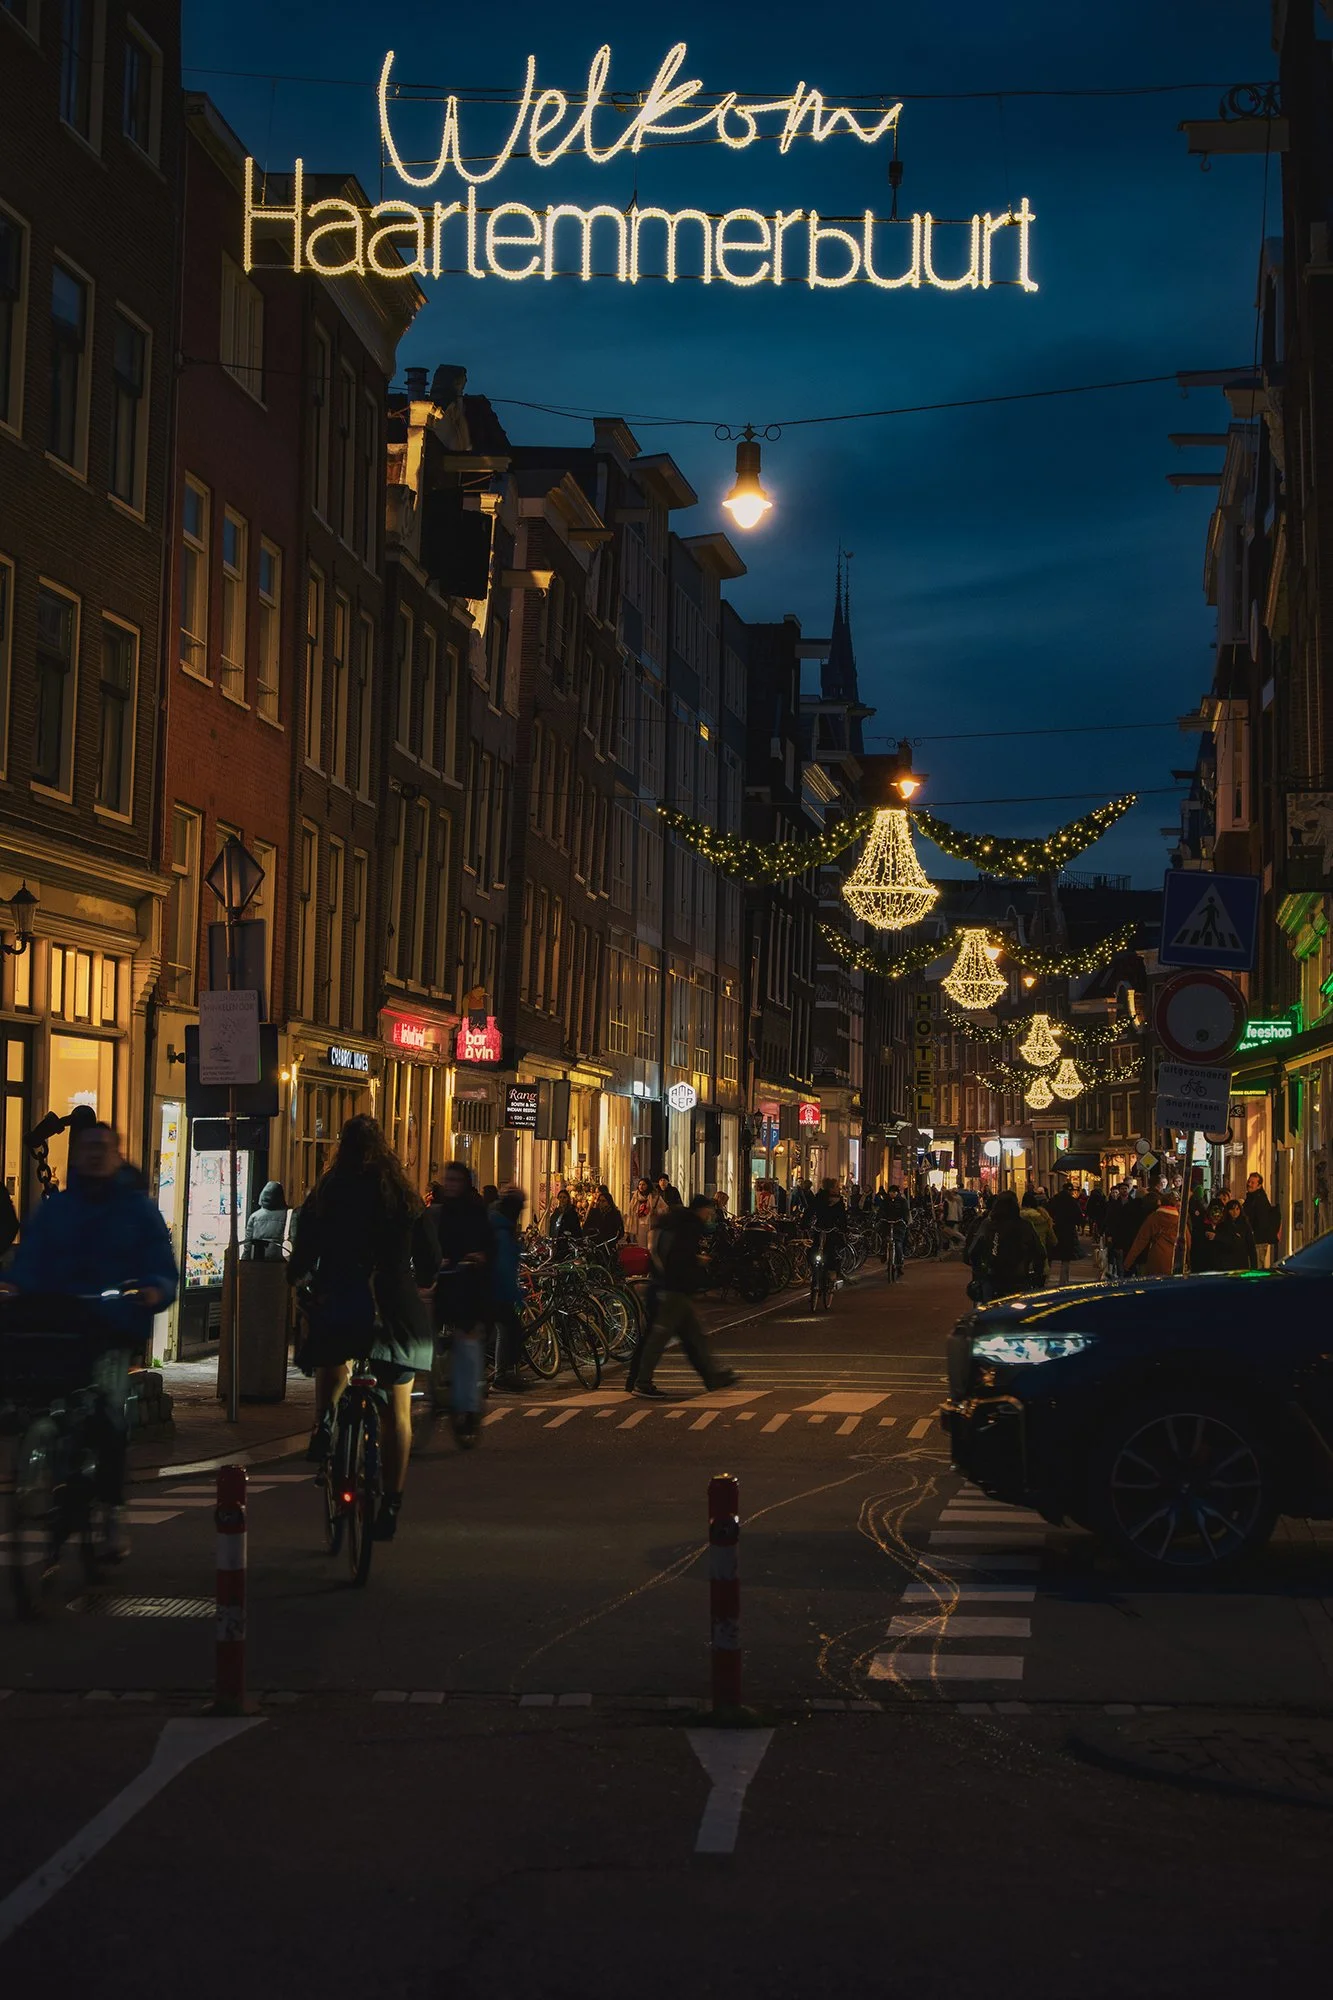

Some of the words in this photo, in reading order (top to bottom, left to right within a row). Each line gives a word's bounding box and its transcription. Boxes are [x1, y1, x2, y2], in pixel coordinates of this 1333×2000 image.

[376, 42, 904, 187] Welkom
[243, 155, 1039, 292] Haarlemmerbuurt
[465, 1030, 487, 1046] bar
[917, 995, 931, 1110] HOTEL
[1163, 1065, 1228, 1081] uitgezonderd
[1182, 1111, 1201, 1119] niet
